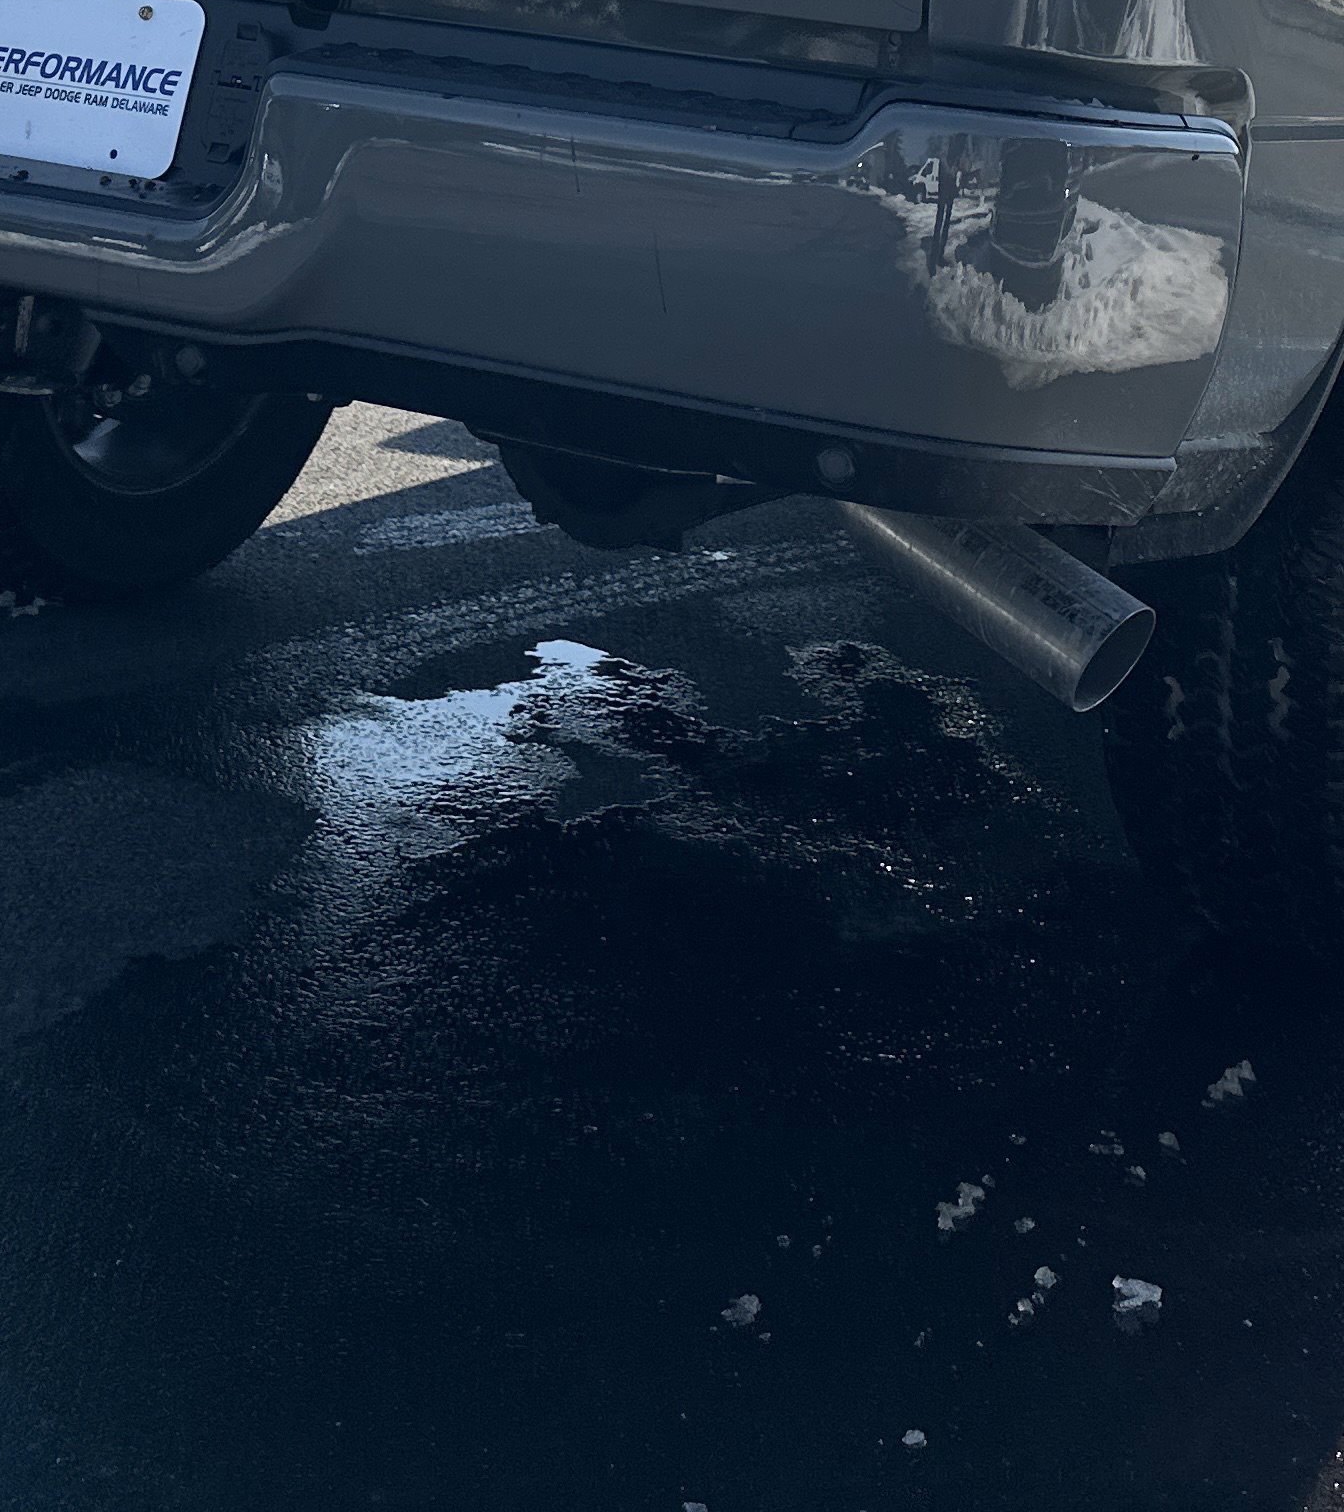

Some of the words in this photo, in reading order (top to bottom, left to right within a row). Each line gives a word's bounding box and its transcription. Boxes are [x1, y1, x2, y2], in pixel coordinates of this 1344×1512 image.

[15, 82, 43, 98] JEEP
[44, 86, 81, 104] DODGE
[83, 92, 110, 109] RAM
[110, 96, 170, 117] DELAWARE
